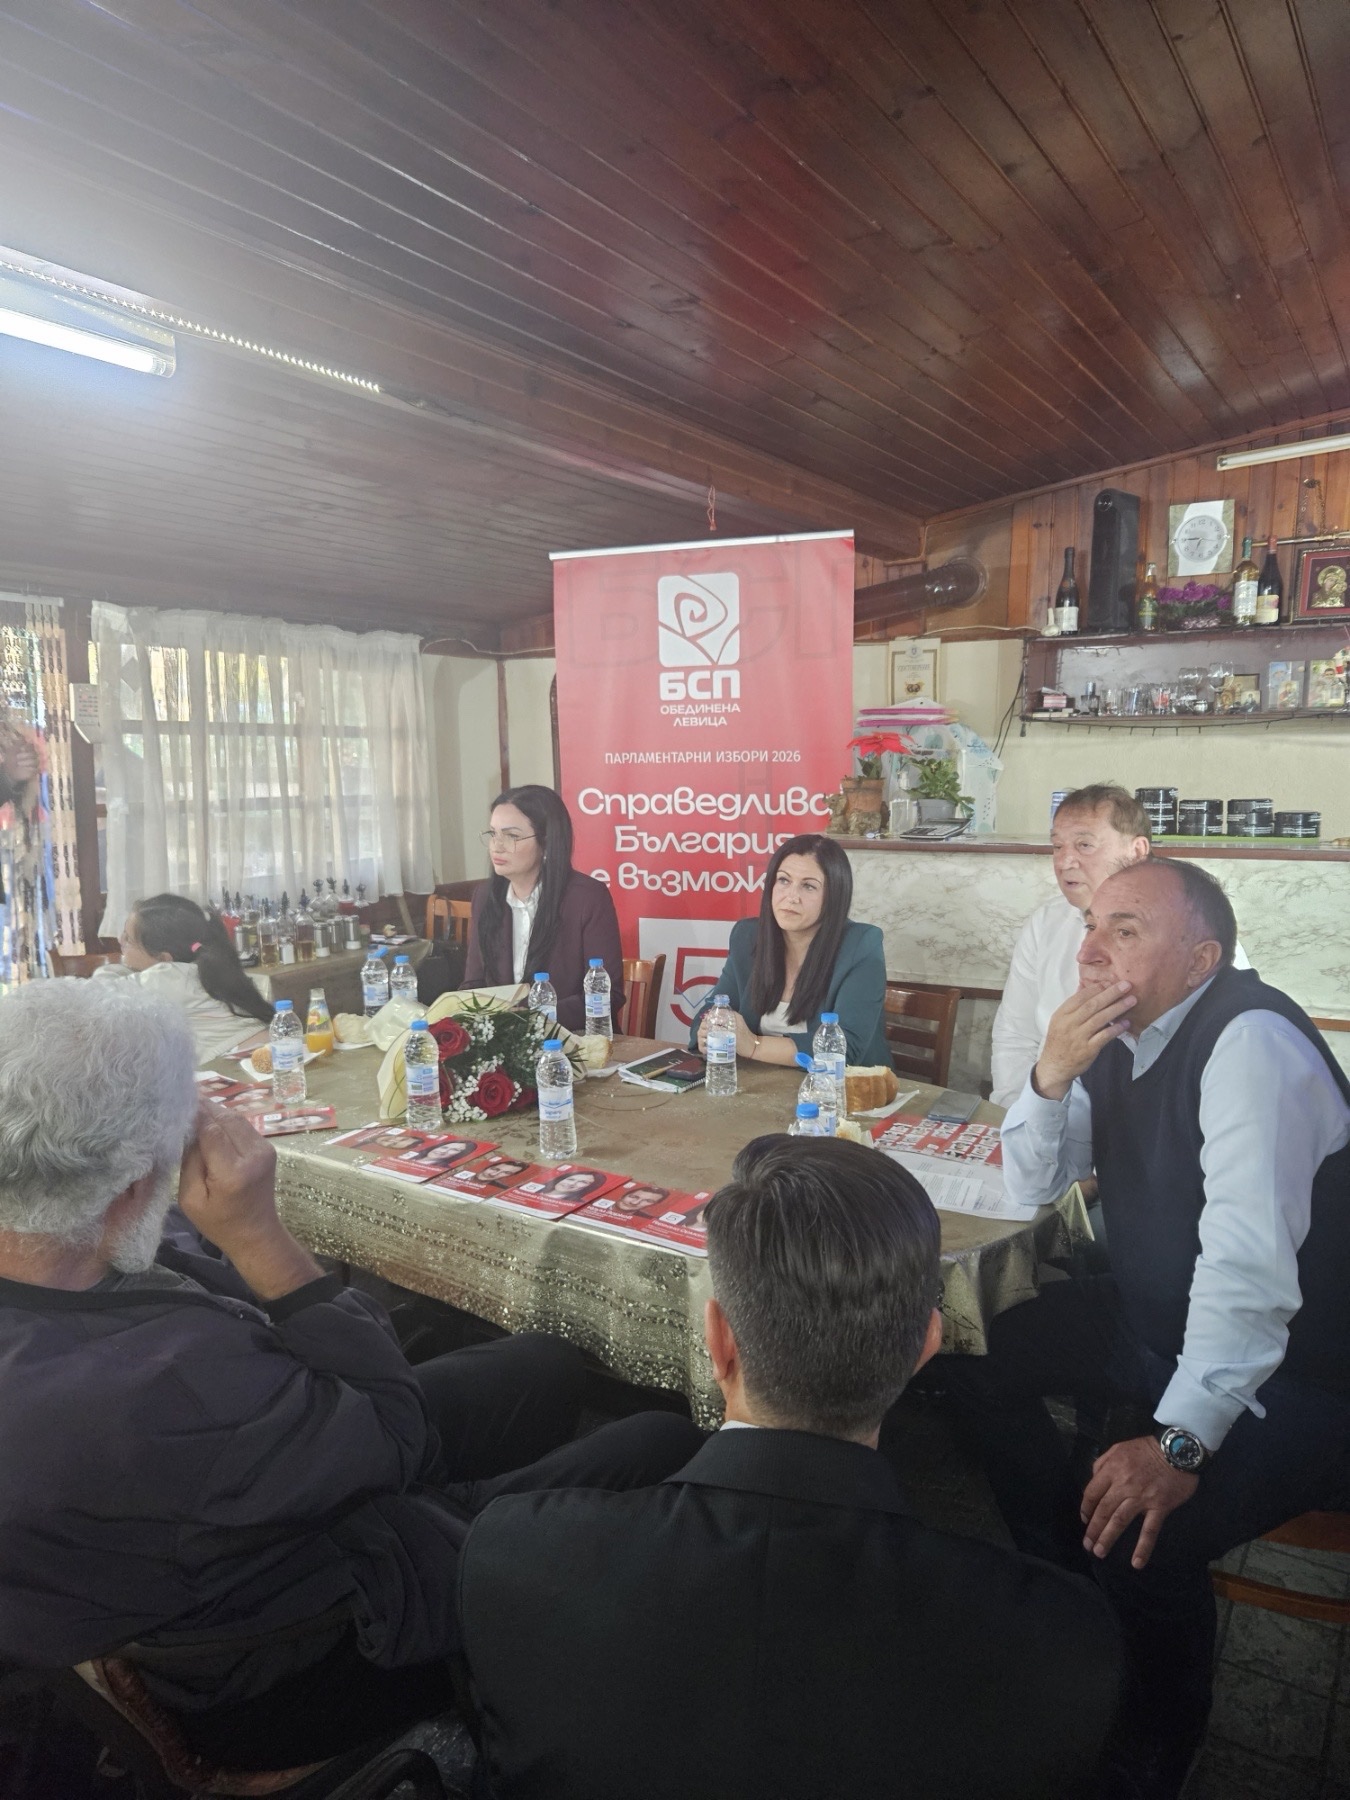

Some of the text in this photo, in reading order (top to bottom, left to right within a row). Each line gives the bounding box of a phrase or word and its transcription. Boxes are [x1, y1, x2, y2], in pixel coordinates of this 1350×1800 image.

[660, 669, 740, 701] БСП
[660, 703, 741, 716] ОБЕДИНЕНА
[673, 716, 728, 728] ЛЕВИЦА
[605, 750, 802, 764] ПАРЛАМЕНТАРНИ ИЗБОРИ 2026
[577, 786, 834, 822] Справедлива
[618, 862, 766, 897] възмож
